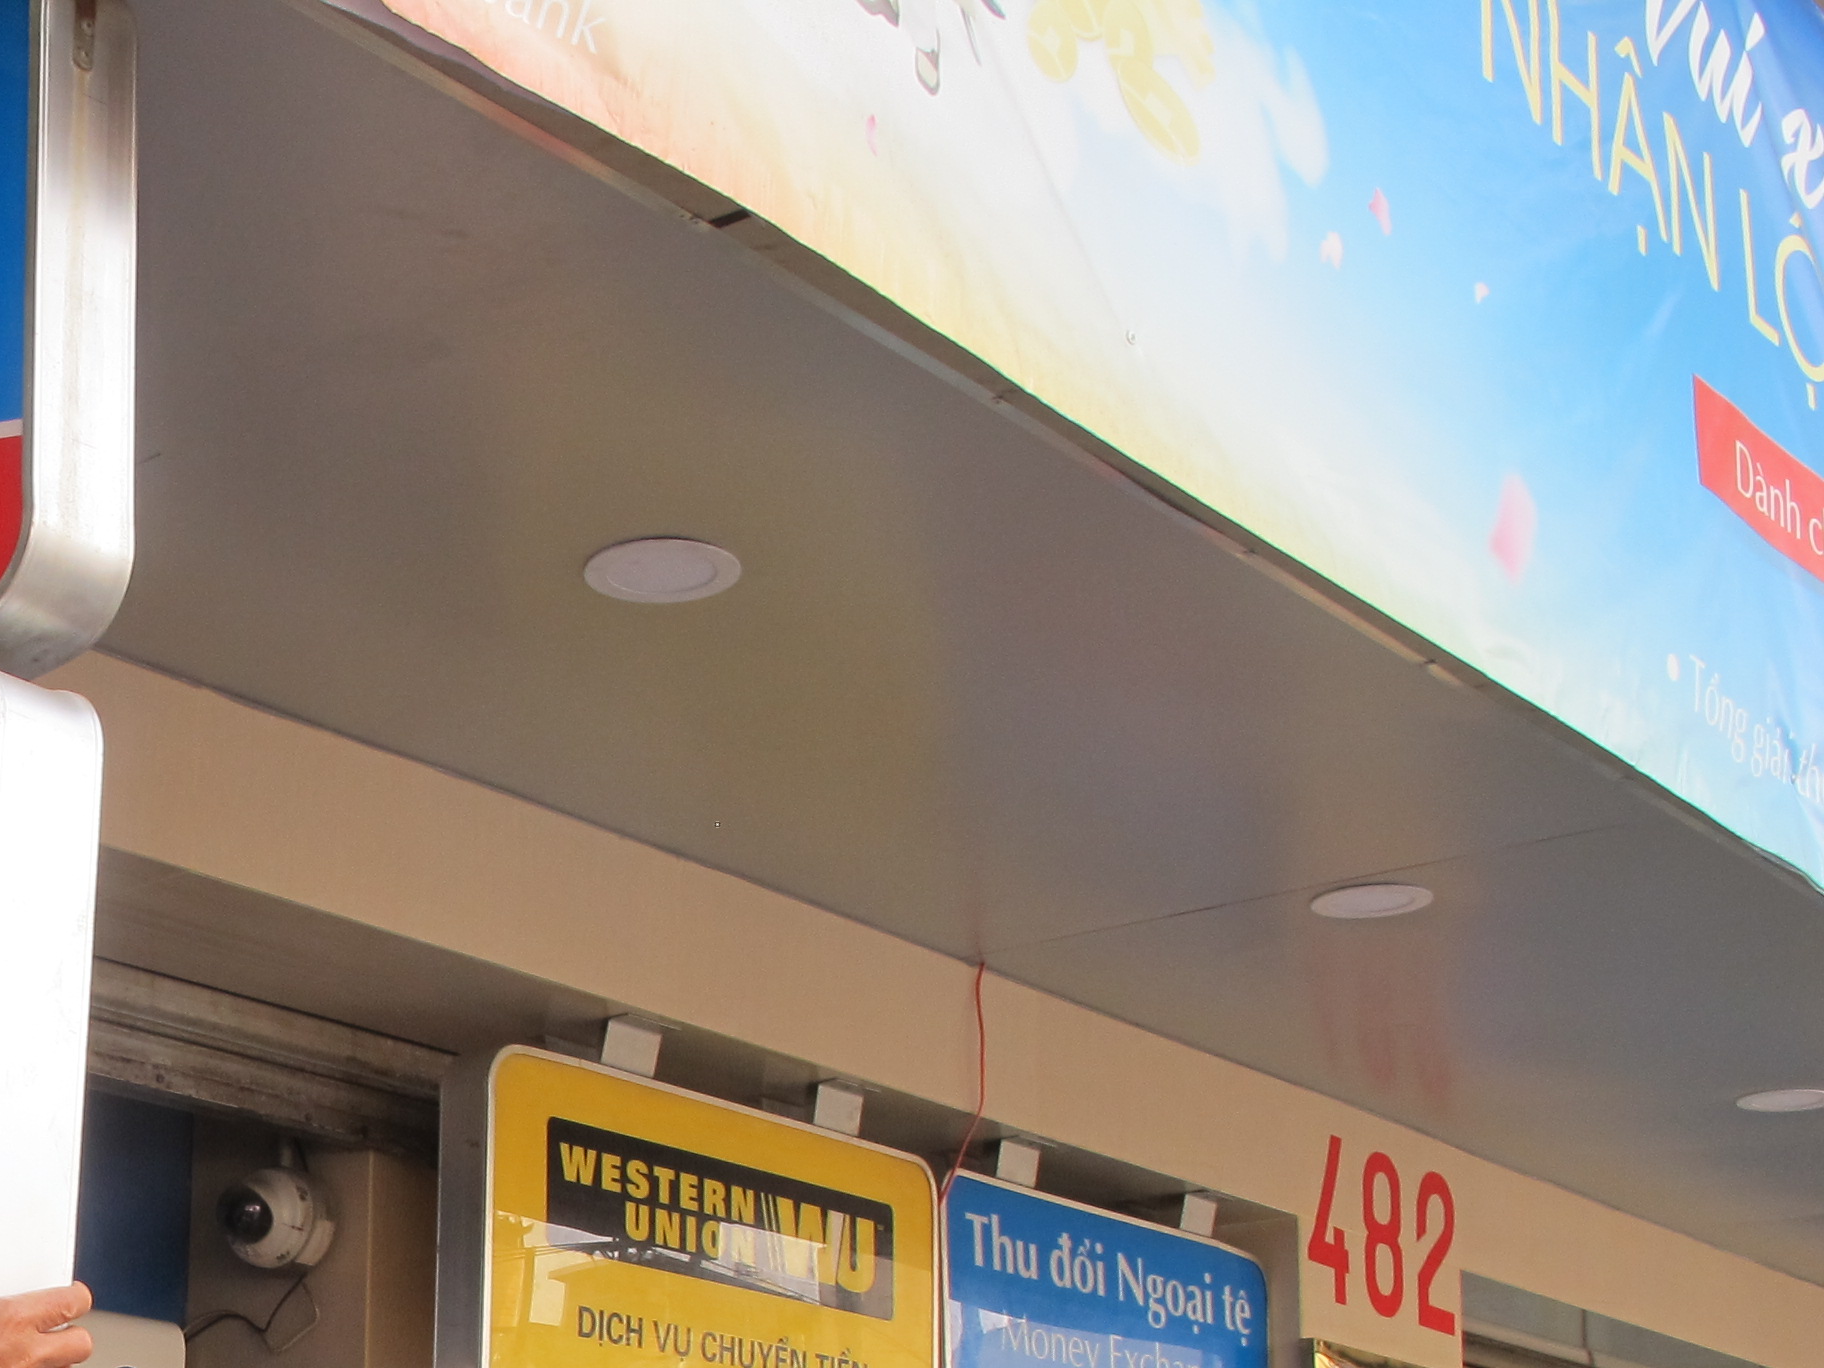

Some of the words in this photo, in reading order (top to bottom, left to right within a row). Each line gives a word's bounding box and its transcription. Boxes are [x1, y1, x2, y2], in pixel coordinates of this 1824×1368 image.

[1481, 0, 1720, 292] NHẬN
[1735, 439, 1801, 540] Dành
[559, 1142, 755, 1225] WESTERN
[626, 1200, 757, 1267] UNION
[965, 1212, 1039, 1280] Thu
[1050, 1232, 1106, 1297] đổi
[1118, 1252, 1214, 1334] Ngoại
[1222, 1285, 1252, 1347] tệ
[1307, 1135, 1457, 1336] 482
[577, 1305, 644, 1348] DỊCH
[651, 1320, 692, 1362] VỤ
